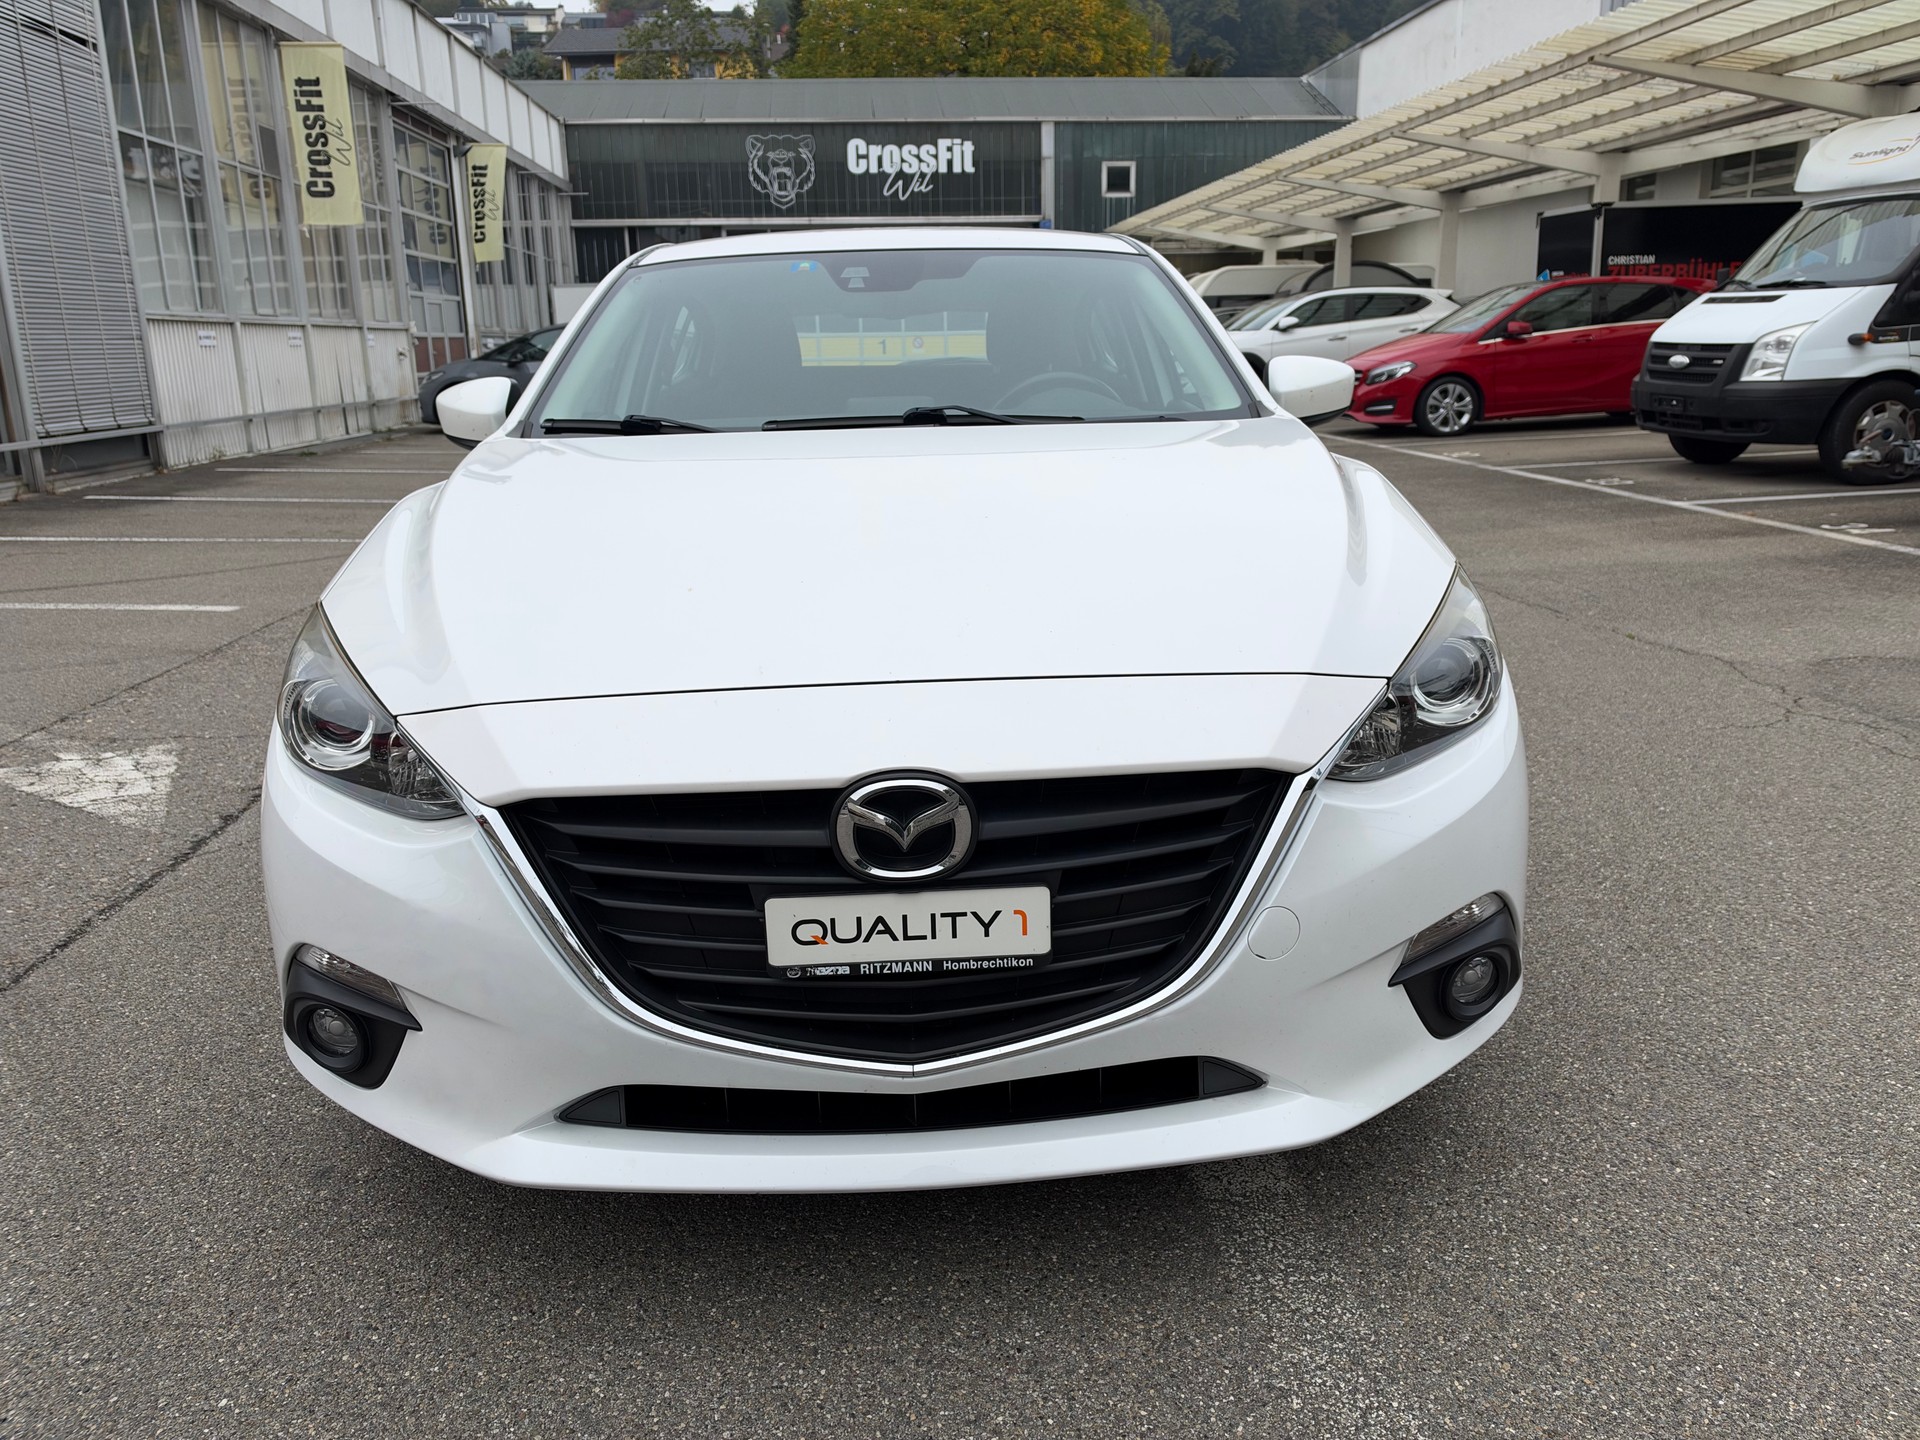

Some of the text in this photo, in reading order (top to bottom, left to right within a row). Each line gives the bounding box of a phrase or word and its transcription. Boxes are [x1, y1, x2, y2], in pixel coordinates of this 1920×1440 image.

[294, 76, 336, 198] CrossFit
[321, 116, 353, 167] Wil
[847, 138, 976, 174] CrossFit
[882, 163, 935, 201] Wil
[471, 164, 488, 244] CrossFit
[1607, 254, 1656, 266] CHRISTIAN
[790, 909, 1003, 946] QUALITY
[860, 960, 933, 976] RITZMANN
[943, 956, 1034, 971] Hombrechtikon
